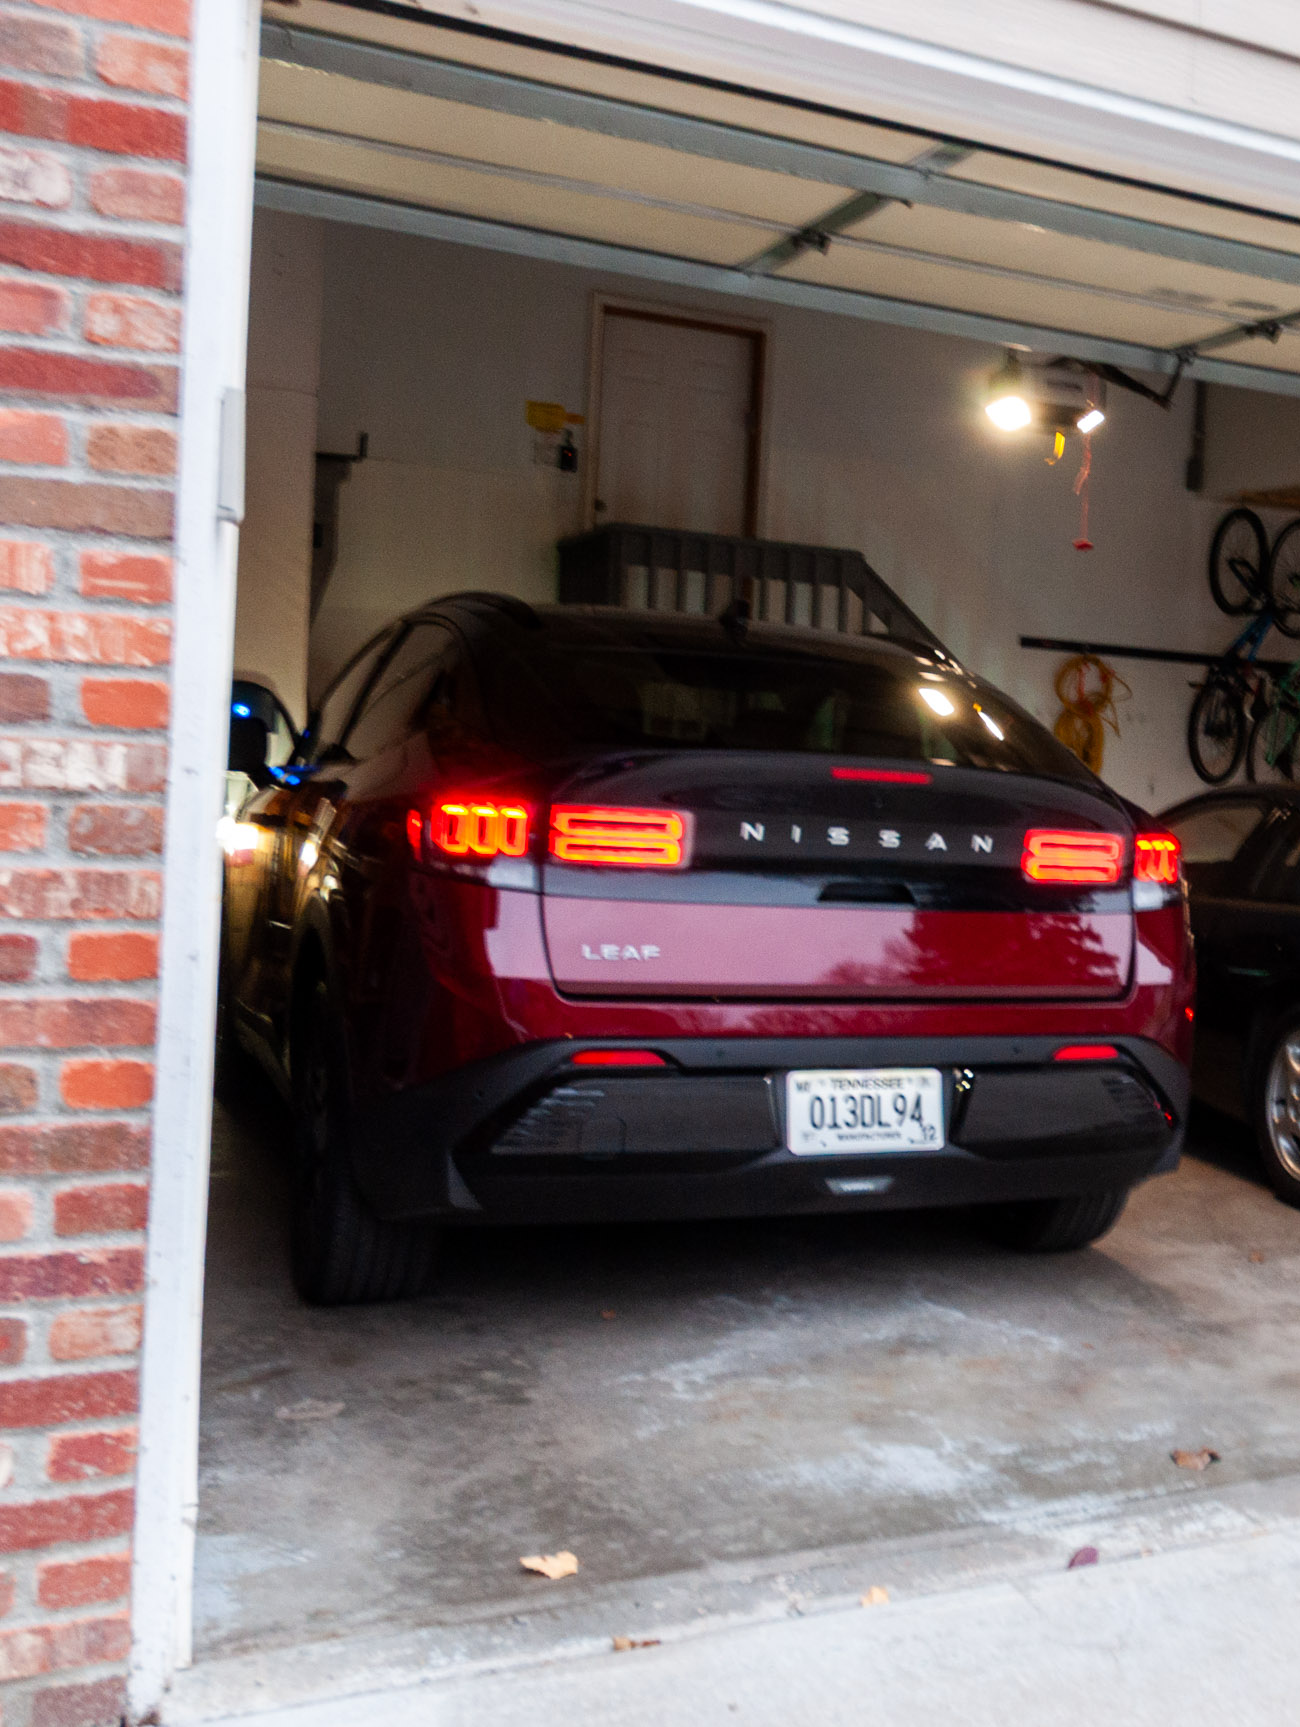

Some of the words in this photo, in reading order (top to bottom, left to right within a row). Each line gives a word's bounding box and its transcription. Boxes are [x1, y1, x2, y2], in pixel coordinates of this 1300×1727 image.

[740, 822, 994, 853] NISSAN
[581, 944, 661, 961] LEAF
[831, 1078, 904, 1091] TENNESSEE
